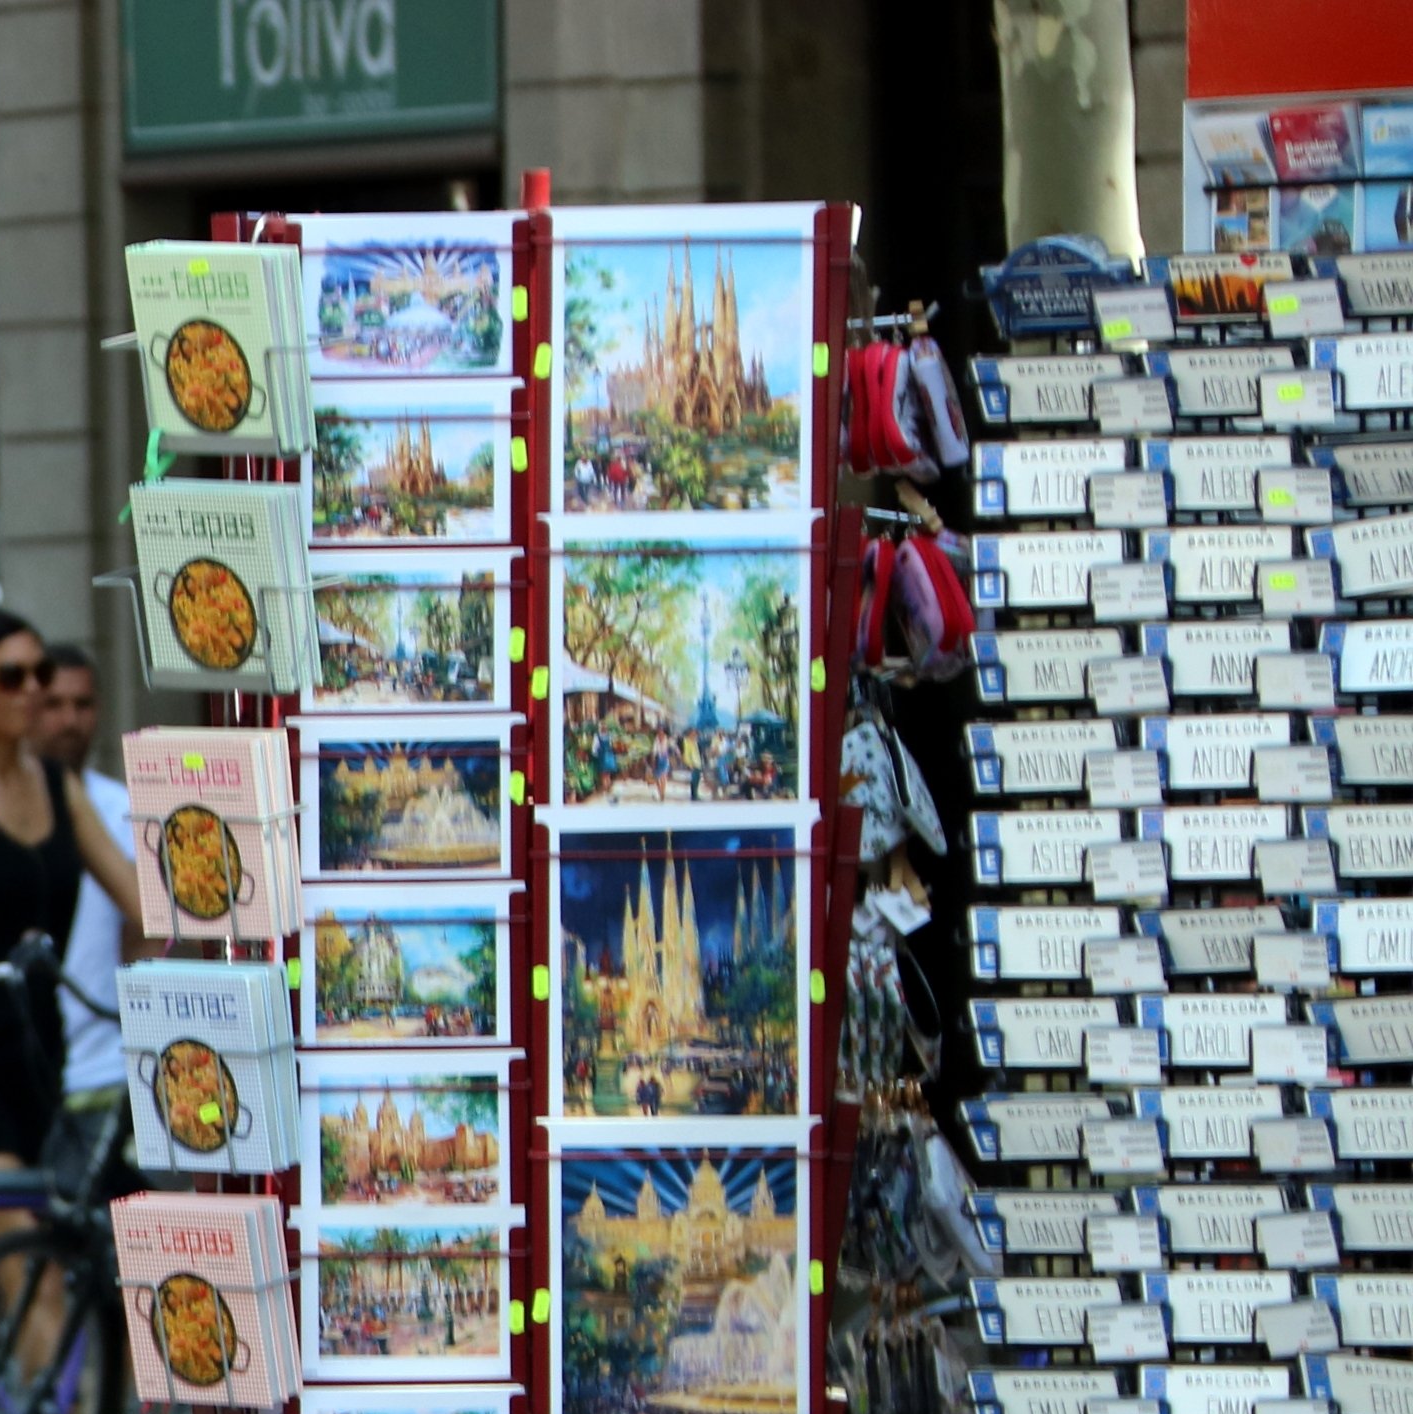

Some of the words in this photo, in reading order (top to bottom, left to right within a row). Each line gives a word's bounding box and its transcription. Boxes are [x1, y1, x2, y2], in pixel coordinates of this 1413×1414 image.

[220, 0, 396, 86] loliva
[173, 267, 250, 311] tapas
[1018, 362, 1105, 375] BARCELONA
[1189, 356, 1275, 369] BARCELONA
[1020, 448, 1108, 461] BARCELONA
[1186, 444, 1273, 458] BARCELONA
[178, 505, 256, 550] tapas
[1018, 540, 1105, 553] BARCELONA
[1188, 534, 1275, 548] BARCELONA
[1031, 561, 1085, 597] ALEIX
[1185, 629, 1273, 643] BARCELONA
[1017, 637, 1104, 650] BARCELONA
[1011, 728, 1098, 741] BARCELONA
[1185, 722, 1273, 737] BARCELONA
[169, 754, 242, 800] tapas
[1017, 818, 1104, 832] BARCELONA
[1183, 813, 1269, 828] BARCELONA
[1015, 914, 1102, 928] BARCELONA
[1178, 912, 1266, 927] BARCELONA
[1014, 1005, 1101, 1018] BARCELONA
[1181, 1001, 1268, 1016] BARCELONA
[1177, 1093, 1264, 1108] BARCELONA
[1006, 1106, 1092, 1117] BARCELONA
[1014, 1200, 1099, 1211] BARCELONA
[1177, 1192, 1264, 1206] BARCELONA
[159, 1223, 234, 1265] tapas
[1016, 1286, 1102, 1298] BARCELONA
[1186, 1278, 1273, 1293] BARCELONA
[1013, 1379, 1101, 1391] BARCELONA
[1184, 1373, 1272, 1388] BARCELONA
